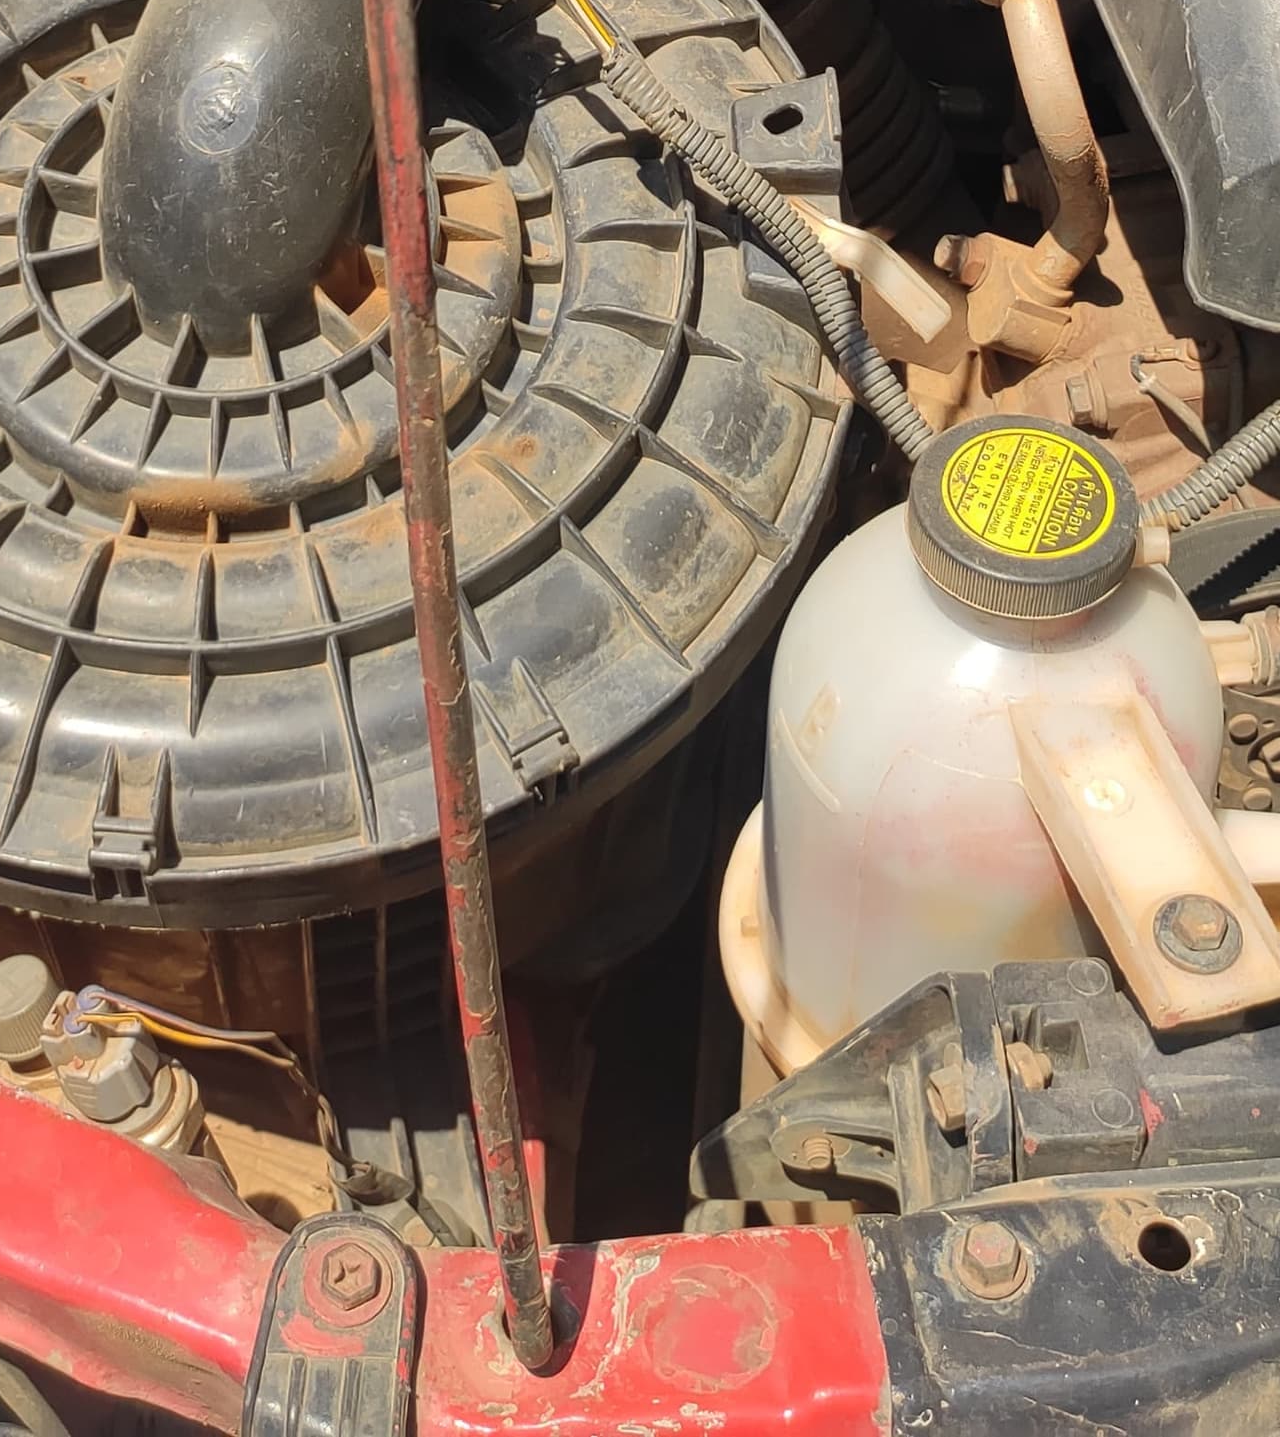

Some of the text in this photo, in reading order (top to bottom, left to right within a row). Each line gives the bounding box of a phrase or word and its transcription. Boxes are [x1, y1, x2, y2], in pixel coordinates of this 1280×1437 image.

[1022, 438, 1033, 450] NE
[960, 443, 995, 511] COOLANT
[977, 452, 1008, 510] ENGINE
[1001, 442, 1046, 539] NEVER OPEN WHEN HOT
[987, 508, 1004, 534] CHAUD
[1041, 479, 1078, 546] CAUTION
